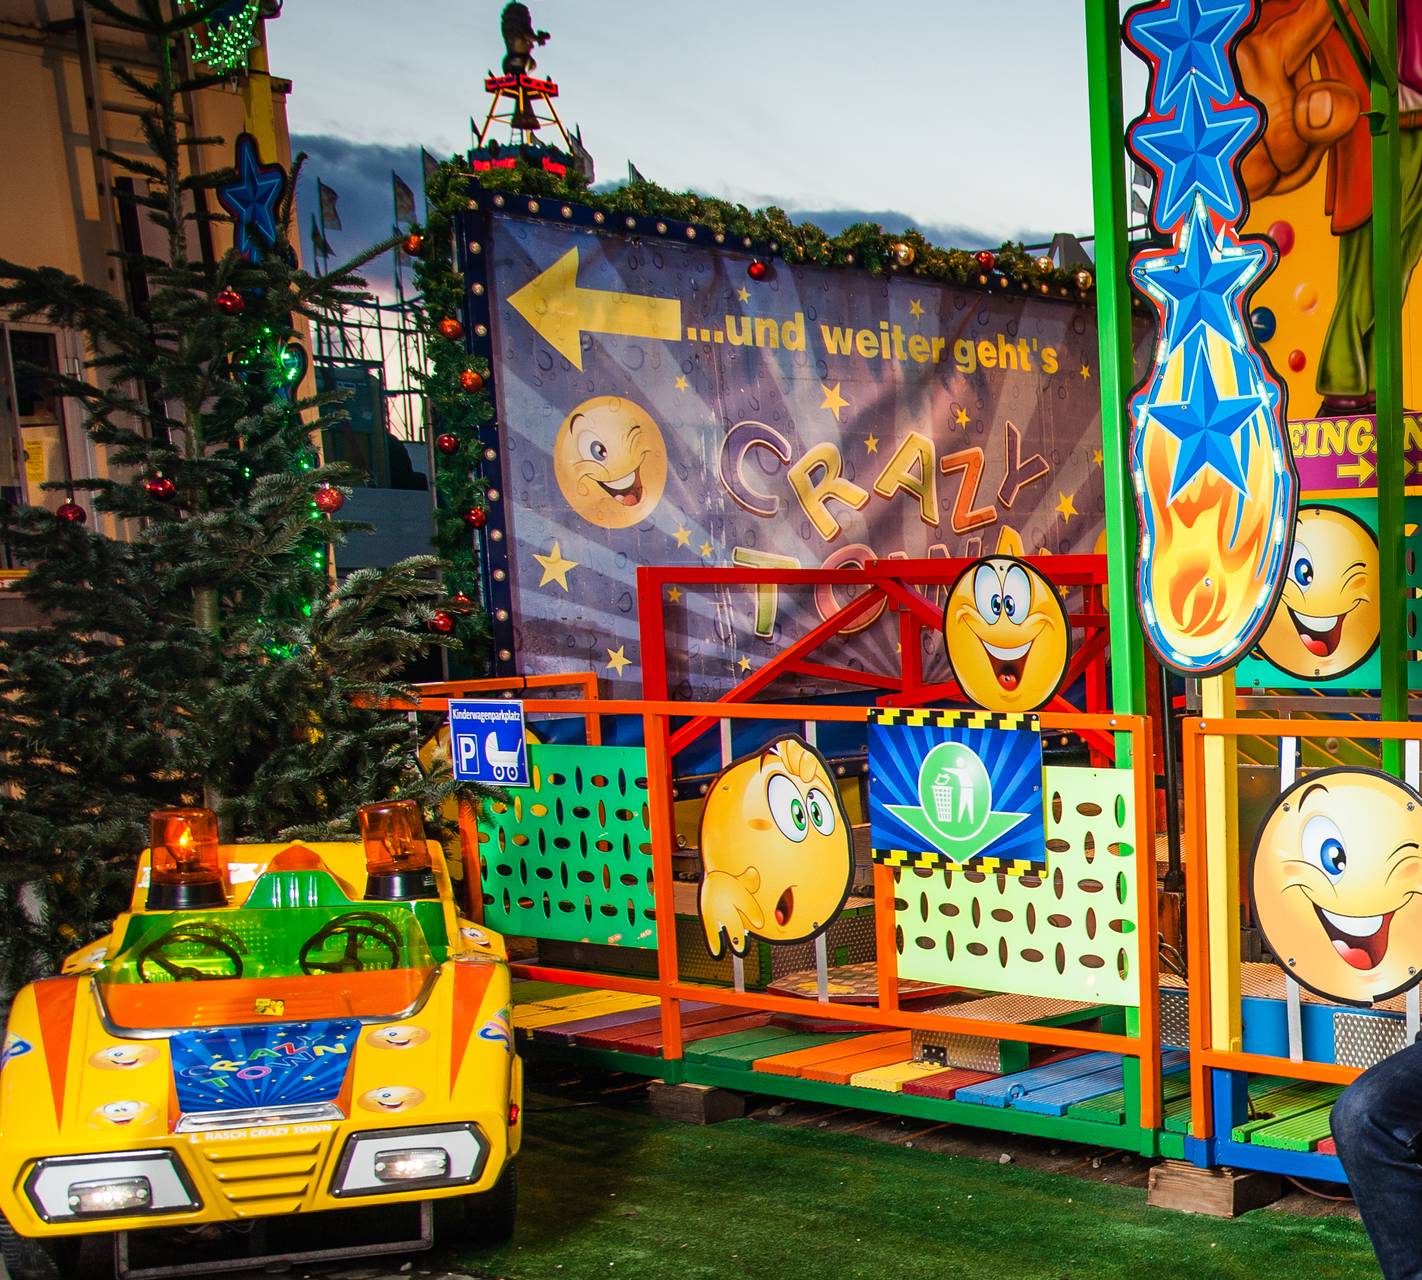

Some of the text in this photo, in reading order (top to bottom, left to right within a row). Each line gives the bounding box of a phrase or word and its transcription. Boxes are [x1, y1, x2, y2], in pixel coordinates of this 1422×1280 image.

[820, 320, 945, 364] weiter
[954, 333, 1059, 375] geht's
[718, 420, 1050, 543] CRAZY
[452, 708, 521, 724] Kinderwagenparkplatz
[459, 736, 476, 772] P
[179, 1032, 326, 1078] CRAZY
[200, 1043, 347, 1088] TOWN
[204, 1130, 247, 1142] RASCH
[250, 1126, 289, 1138] CRAZY
[292, 1123, 333, 1135] TOWN
